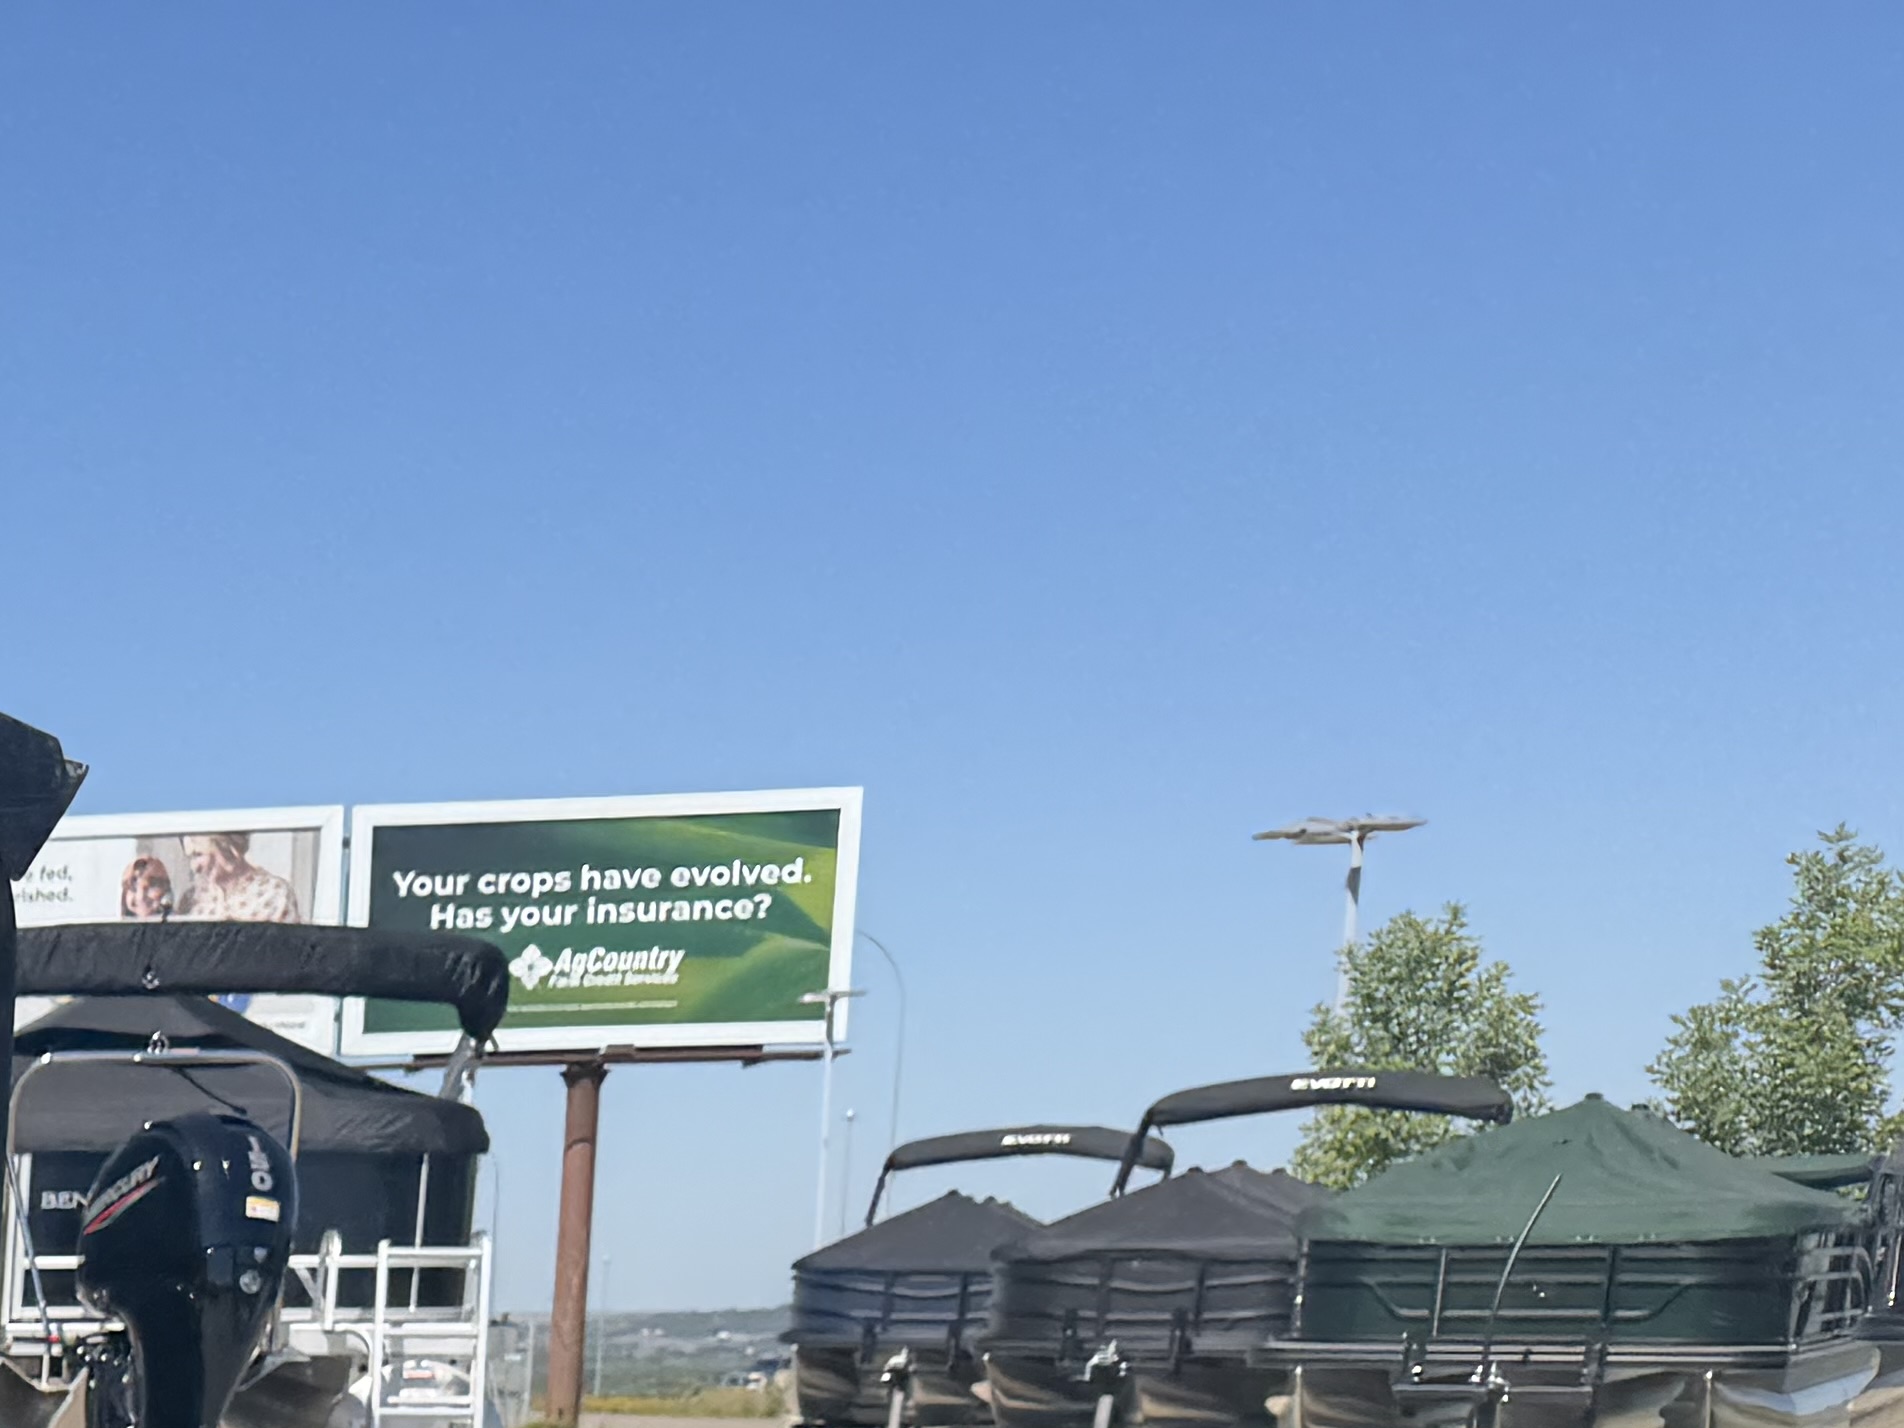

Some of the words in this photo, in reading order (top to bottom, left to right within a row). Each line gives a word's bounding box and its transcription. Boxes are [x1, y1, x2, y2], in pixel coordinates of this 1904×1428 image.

[393, 870, 470, 898] Your
[477, 868, 572, 899] crops
[580, 864, 661, 891] have
[670, 857, 812, 888] evolved.
[430, 903, 493, 931] Has
[500, 903, 578, 934] your
[586, 893, 773, 924] insurance?
[553, 946, 686, 977] AgCountry
